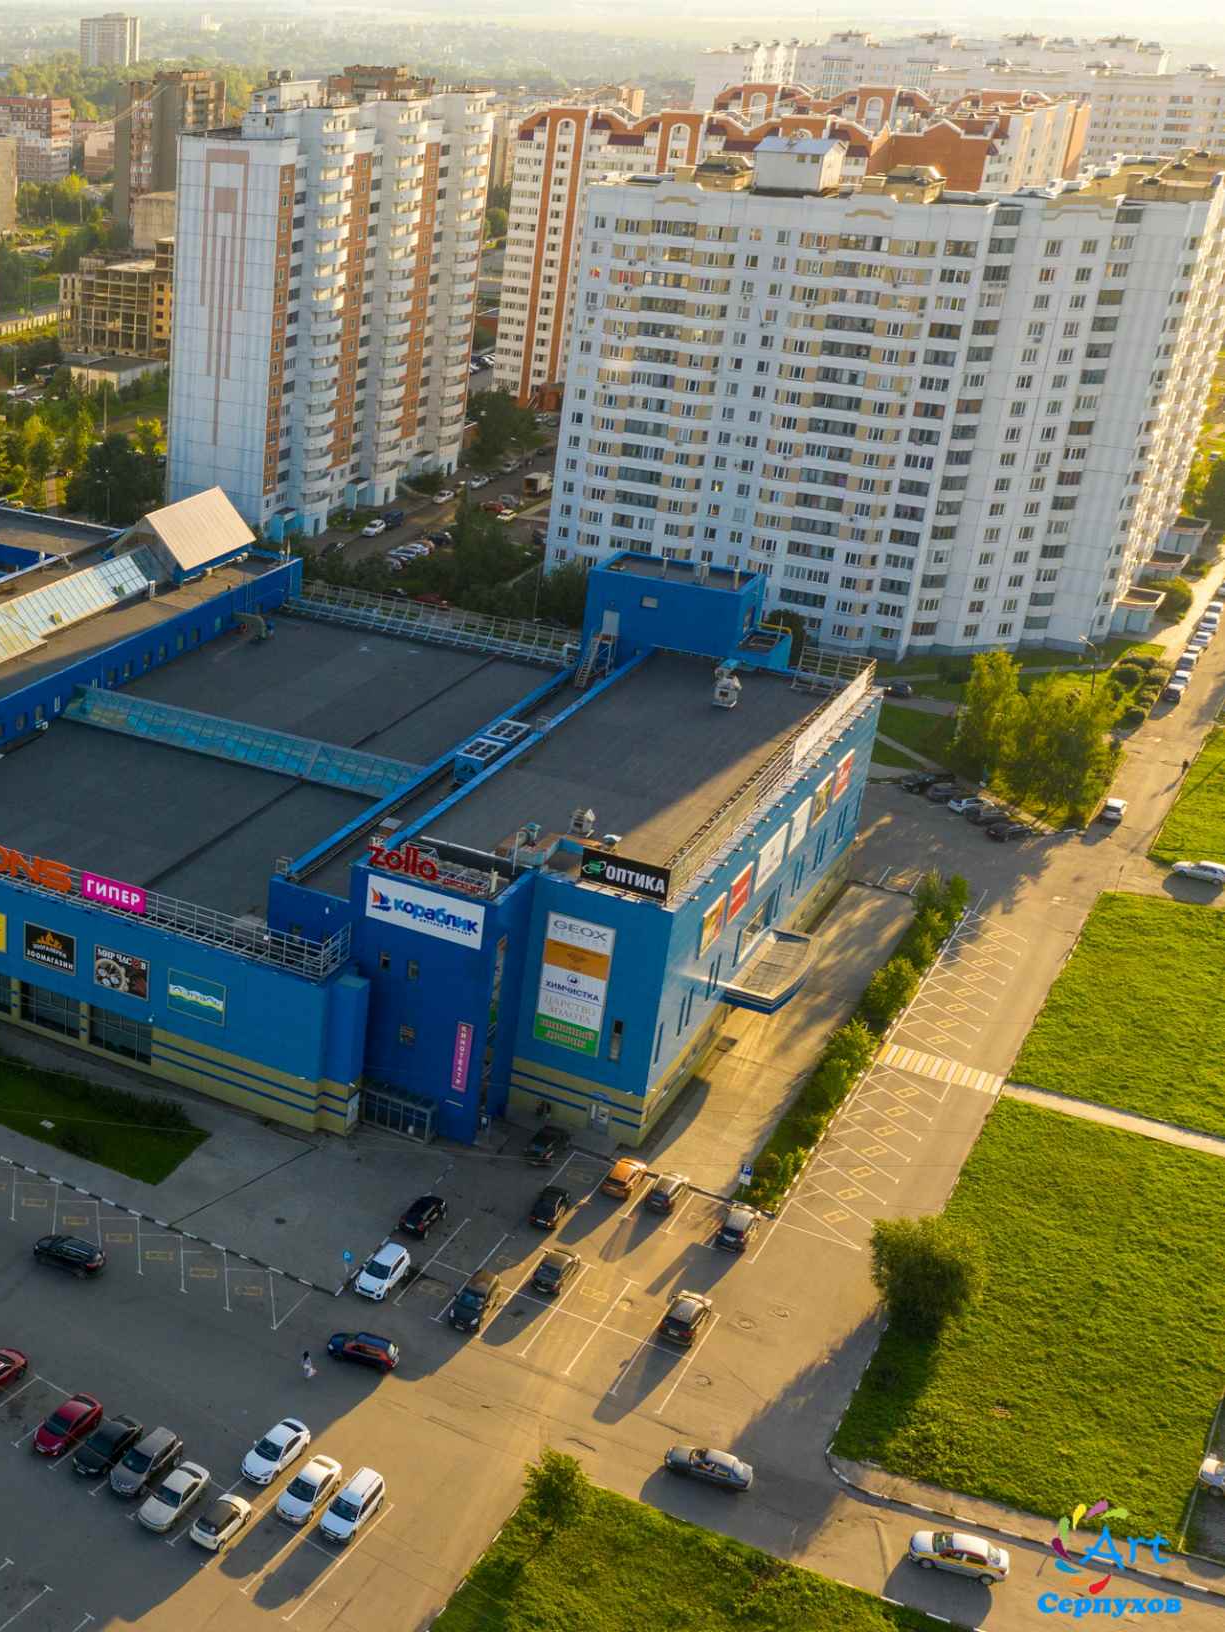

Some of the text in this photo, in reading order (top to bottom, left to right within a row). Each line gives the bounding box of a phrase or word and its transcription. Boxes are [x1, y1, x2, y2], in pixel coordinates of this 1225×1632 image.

[367, 843, 439, 880] zollo
[86, 879, 141, 907] ГИПЕР
[605, 865, 665, 893] ОПТИКА
[394, 898, 479, 934] кораблик
[553, 919, 608, 942] GEOX
[26, 950, 74, 971] ЗООМАГАЗИН
[545, 980, 600, 1002] ХИМЧИСТКА
